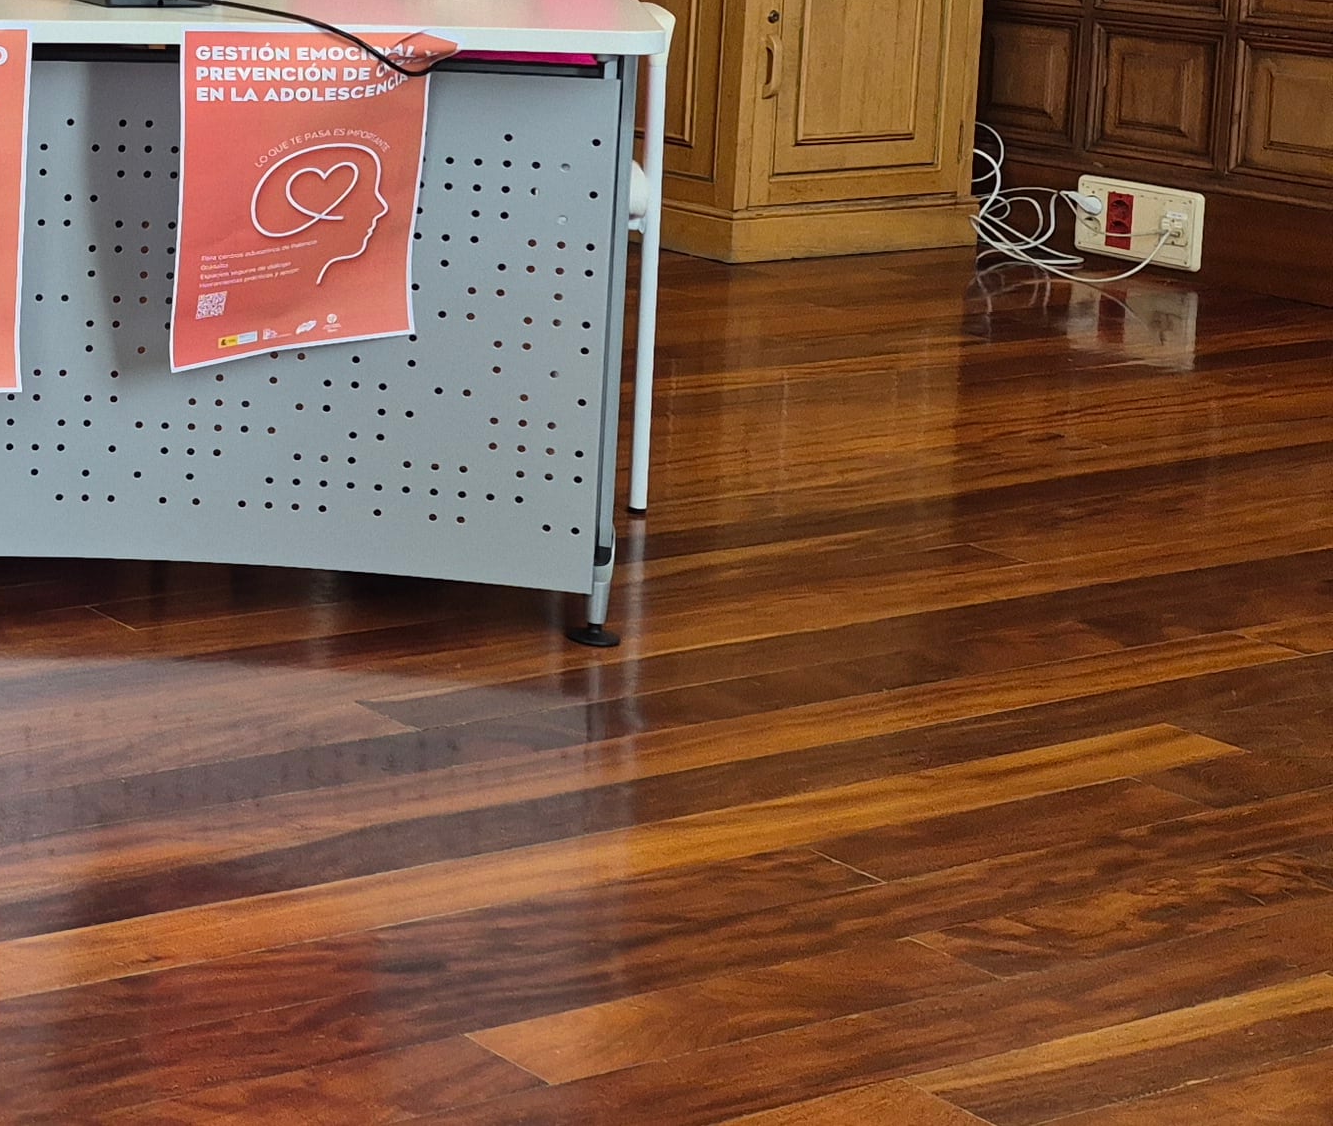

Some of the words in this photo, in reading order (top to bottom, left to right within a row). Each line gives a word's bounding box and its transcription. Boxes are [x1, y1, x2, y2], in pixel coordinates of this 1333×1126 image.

[195, 43, 290, 61] GESTIÓN
[196, 64, 336, 81] PREVENCIÓN
[343, 67, 370, 81] DE
[196, 87, 224, 102] EN
[231, 87, 259, 102] LA
[264, 75, 408, 102] ADOLESCENCIA
[254, 155, 268, 168] LO
[268, 141, 289, 158] QUE
[290, 135, 303, 147] TE
[304, 129, 331, 142] PASA
[333, 128, 345, 136] ES
